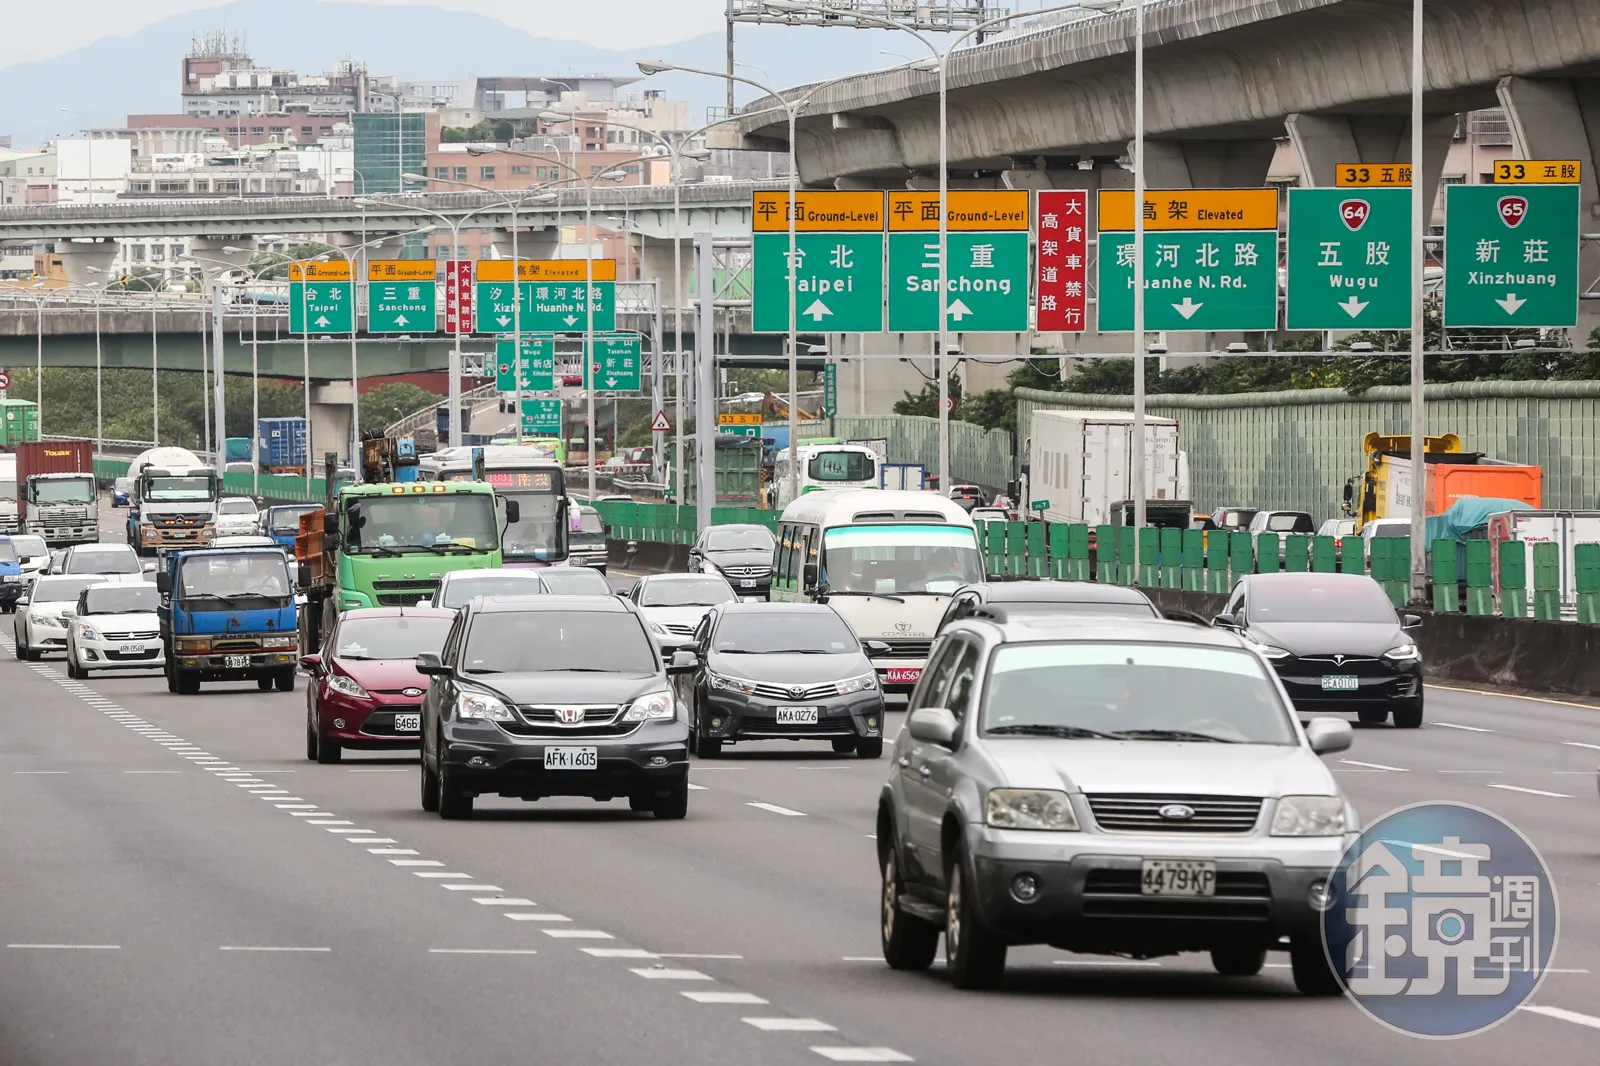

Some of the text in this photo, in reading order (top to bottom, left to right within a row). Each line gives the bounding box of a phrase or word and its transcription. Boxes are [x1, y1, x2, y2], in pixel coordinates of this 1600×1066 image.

[1344, 168, 1412, 183] 33 五股
[1499, 164, 1576, 180] 33 五股
[757, 201, 878, 222] 平面 Ground-Level
[893, 200, 1024, 222] 平面 Ground-Level
[1142, 200, 1243, 221] 高架 Elevated
[1343, 206, 1365, 219] 64
[1502, 203, 1523, 217] 65
[782, 244, 854, 269] 台北
[921, 243, 995, 269] 三重
[1115, 242, 1260, 268] 環河北路
[1317, 241, 1391, 267] 五股
[1475, 238, 1549, 263] 新莊
[1041, 212, 1058, 311] 高架道路
[1065, 198, 1082, 324] 大貨車禁行
[292, 264, 354, 277] 平面 Ground-Leve
[371, 264, 396, 276] 平面
[1198, 275, 1216, 289] N.
[1220, 275, 1247, 289] Rd.
[1329, 274, 1379, 290] Wugu
[1467, 271, 1557, 287] Xinzhuang
[305, 287, 342, 301] 台北
[383, 286, 421, 301] 三重
[461, 264, 471, 329] 大貨車禁行
[535, 286, 603, 301] 環河北路
[309, 304, 339, 313] Taipei
[378, 303, 427, 312] Sanchong
[536, 303, 574, 313] Huanhe
[576, 303, 586, 313] N.
[605, 358, 633, 368] 新莊
[721, 415, 734, 423] 33
[518, 473, 549, 487] 南投
[887, 670, 920, 680] KAA-6569
[777, 710, 817, 721] AKA-0276
[546, 752, 596, 766] AFK-1603
